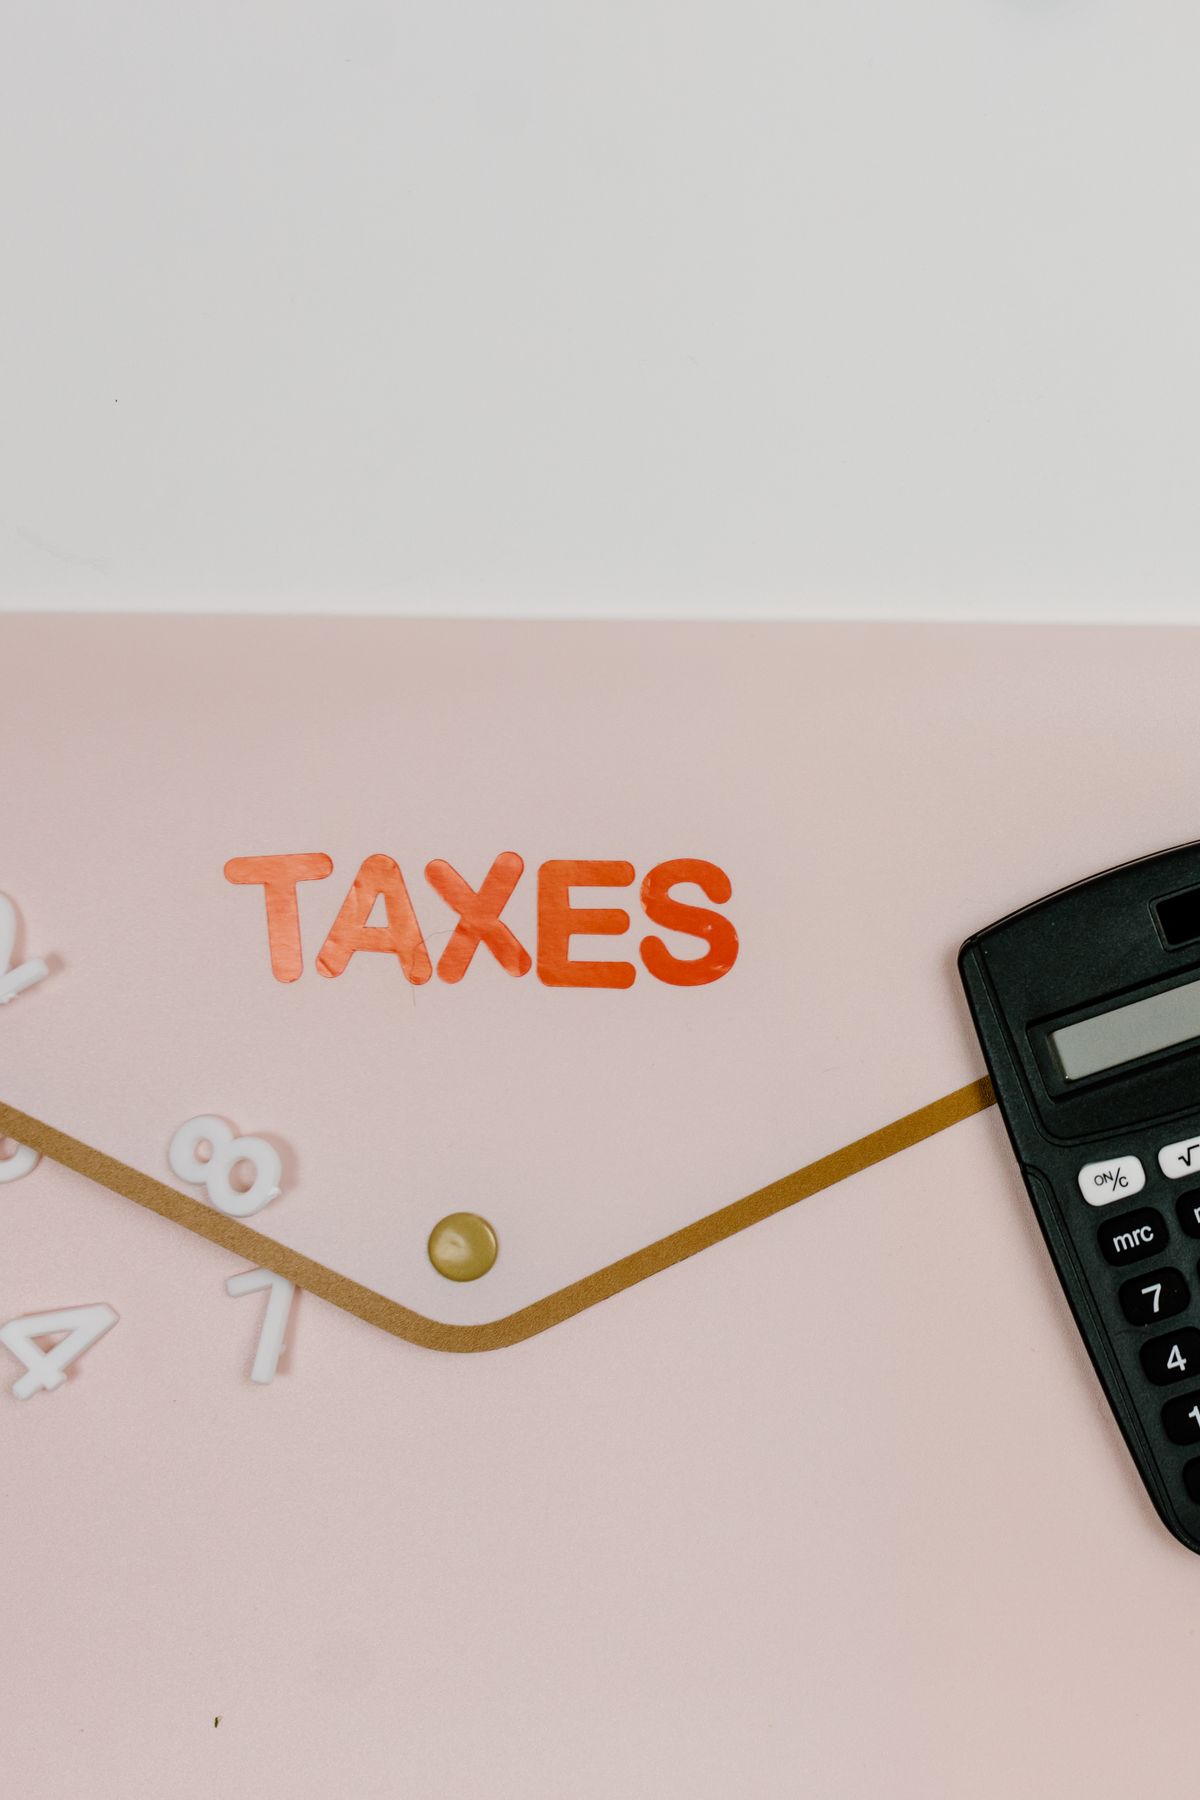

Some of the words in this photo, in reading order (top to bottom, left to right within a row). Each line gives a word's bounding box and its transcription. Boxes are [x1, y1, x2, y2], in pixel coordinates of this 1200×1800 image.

[224, 852, 739, 989] TAXES
[169, 1114, 282, 1217] 8
[1113, 1223, 1155, 1253] mrc
[1141, 1283, 1162, 1313] 7
[1, 1302, 120, 1399] 4
[1166, 1344, 1187, 1371] 4
